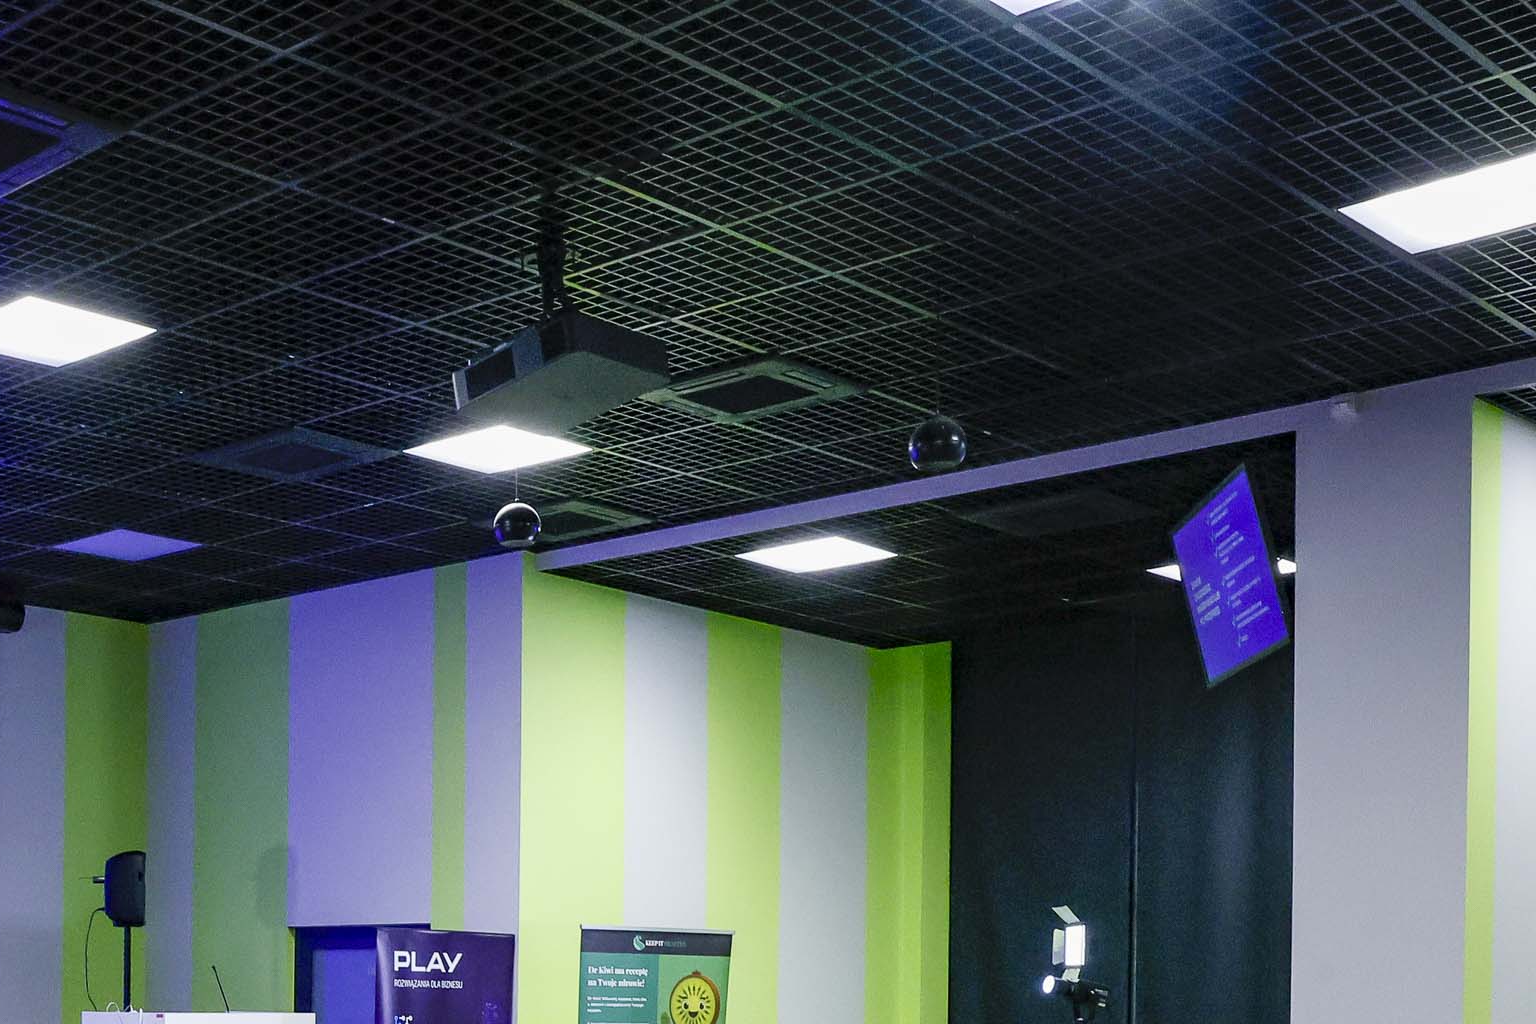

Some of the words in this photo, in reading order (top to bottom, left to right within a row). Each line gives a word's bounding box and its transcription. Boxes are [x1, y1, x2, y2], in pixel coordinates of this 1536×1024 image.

[394, 950, 463, 973] PLAY
[394, 979, 430, 989] ROZWIĄZANIA
[430, 980, 441, 989] DLA
[441, 980, 463, 989] BIZNESU
